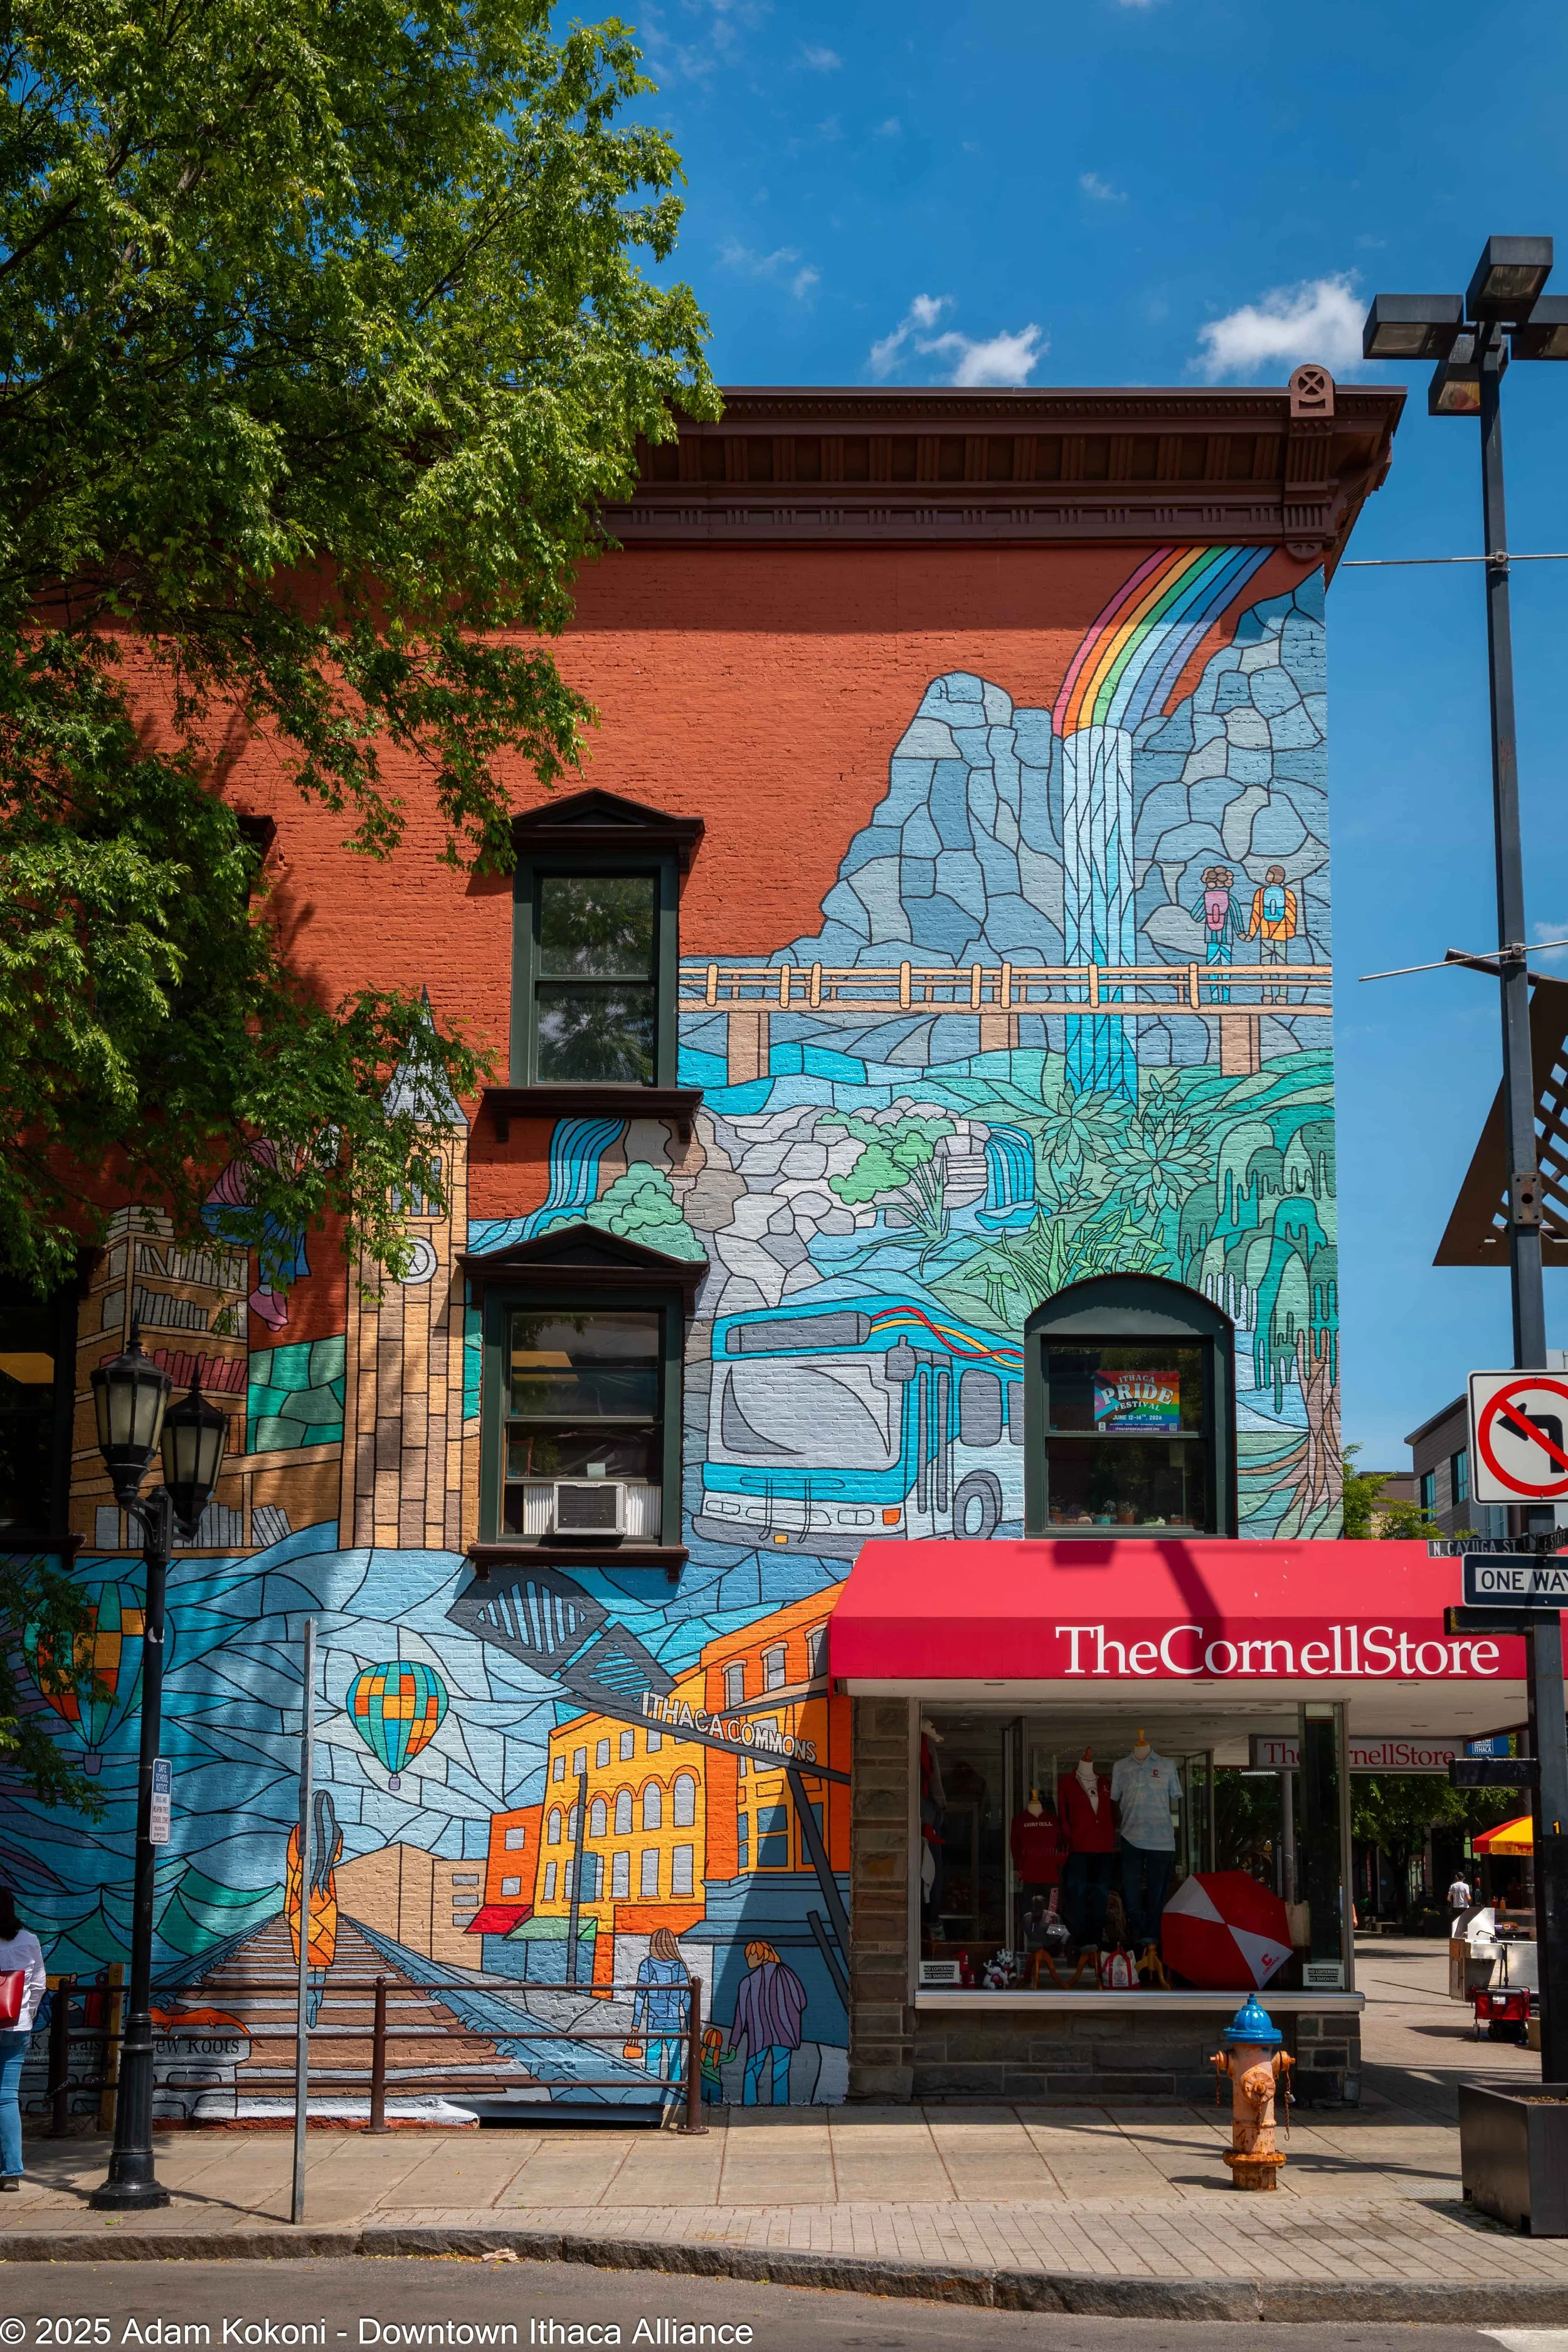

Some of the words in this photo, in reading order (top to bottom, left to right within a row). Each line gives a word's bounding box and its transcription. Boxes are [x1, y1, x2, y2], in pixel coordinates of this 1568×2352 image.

[1119, 1374, 1155, 1383] ITHACA
[1101, 1383, 1173, 1405] PRIDE
[1115, 1401, 1160, 1411] FESTIVAL
[1433, 1542, 1444, 1556] N.
[1448, 1540, 1496, 1556] CAYUGA
[1544, 1537, 1549, 1550] E
[1550, 1531, 1565, 1549] STATE
[1481, 1570, 1524, 1590] ONE
[1055, 1625, 1500, 1675] TheCornellStore
[642, 1691, 725, 1740] ITHACA
[728, 1720, 816, 1763] COMMONS
[158, 1764, 167, 1773] SAFE
[156, 1774, 169, 1783] SCHOOL
[156, 1784, 167, 1793] NOTICE
[1553, 1821, 1559, 1834] 1
[152, 2039, 180, 2054] ew
[188, 2039, 240, 2053] Roots
